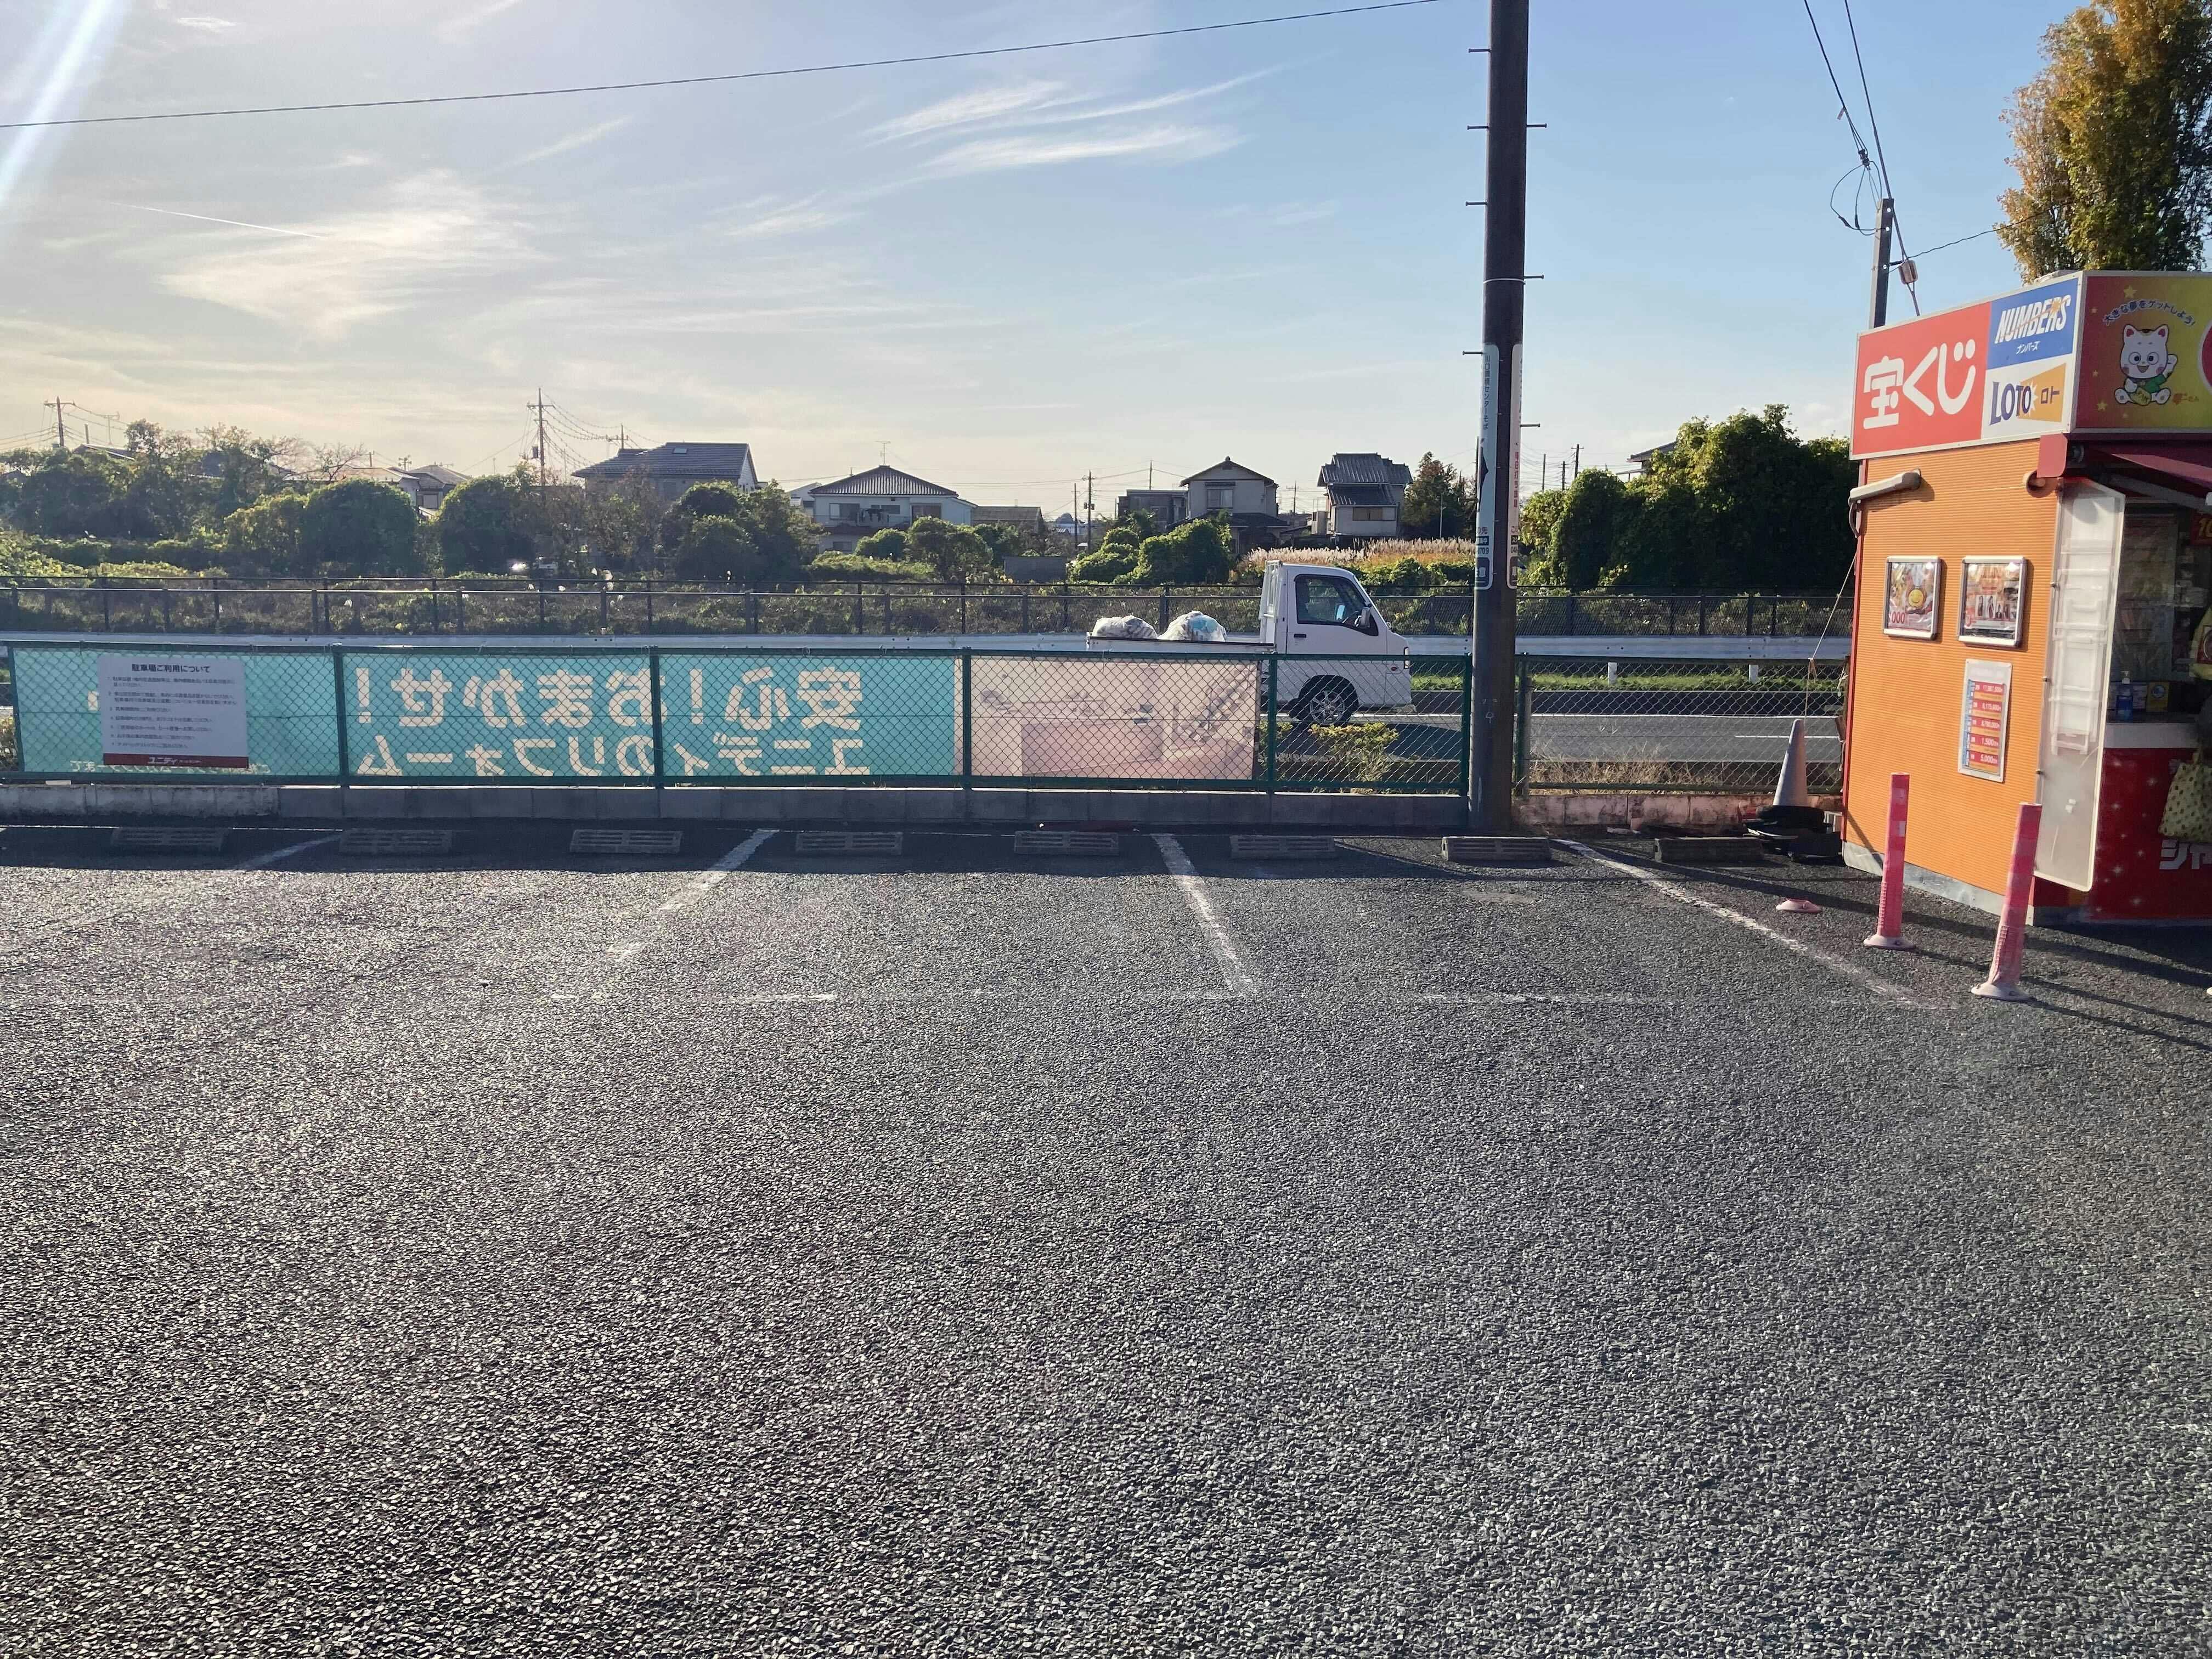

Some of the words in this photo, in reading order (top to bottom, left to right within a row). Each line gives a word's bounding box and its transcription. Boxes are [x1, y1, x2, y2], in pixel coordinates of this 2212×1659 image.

[1994, 294, 2072, 345] NUMBERS
[2016, 340, 2041, 355] ナンバーズ
[1863, 338, 1976, 430] 宝くじ
[1989, 381, 2032, 426] LOTO
[2040, 385, 2060, 405] ロト
